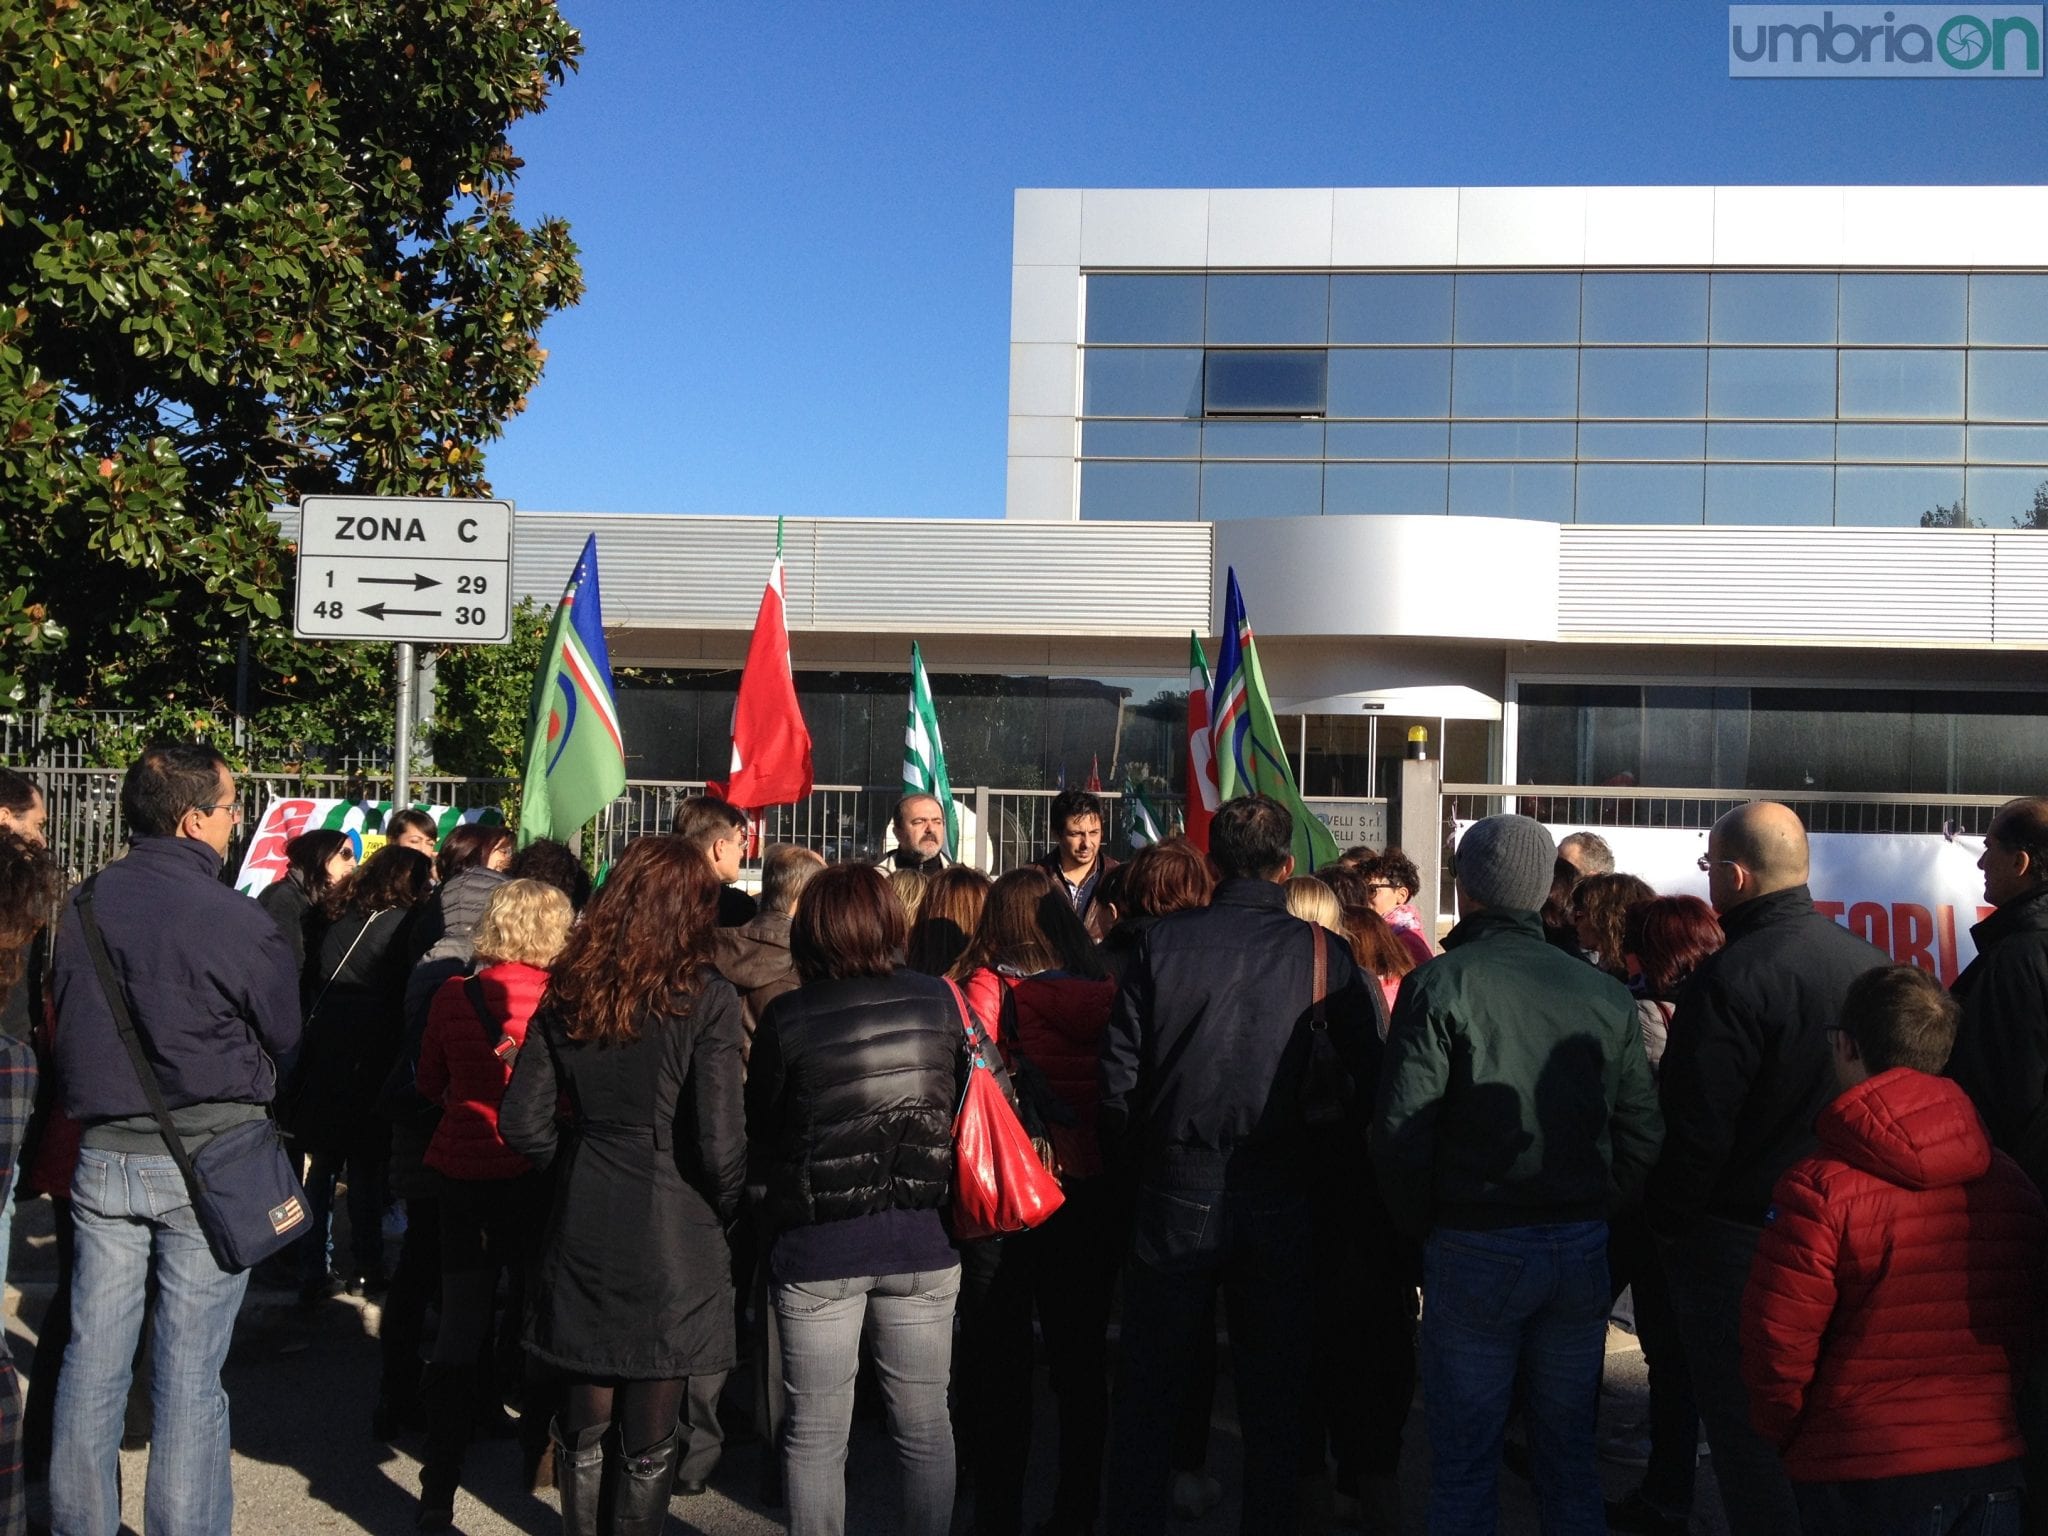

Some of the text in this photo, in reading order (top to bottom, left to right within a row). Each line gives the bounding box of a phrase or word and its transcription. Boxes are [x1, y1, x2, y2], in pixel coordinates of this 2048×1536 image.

[335, 516, 479, 543] ZONA C
[325, 570, 487, 595] 1 29
[313, 601, 486, 626] 48 30
